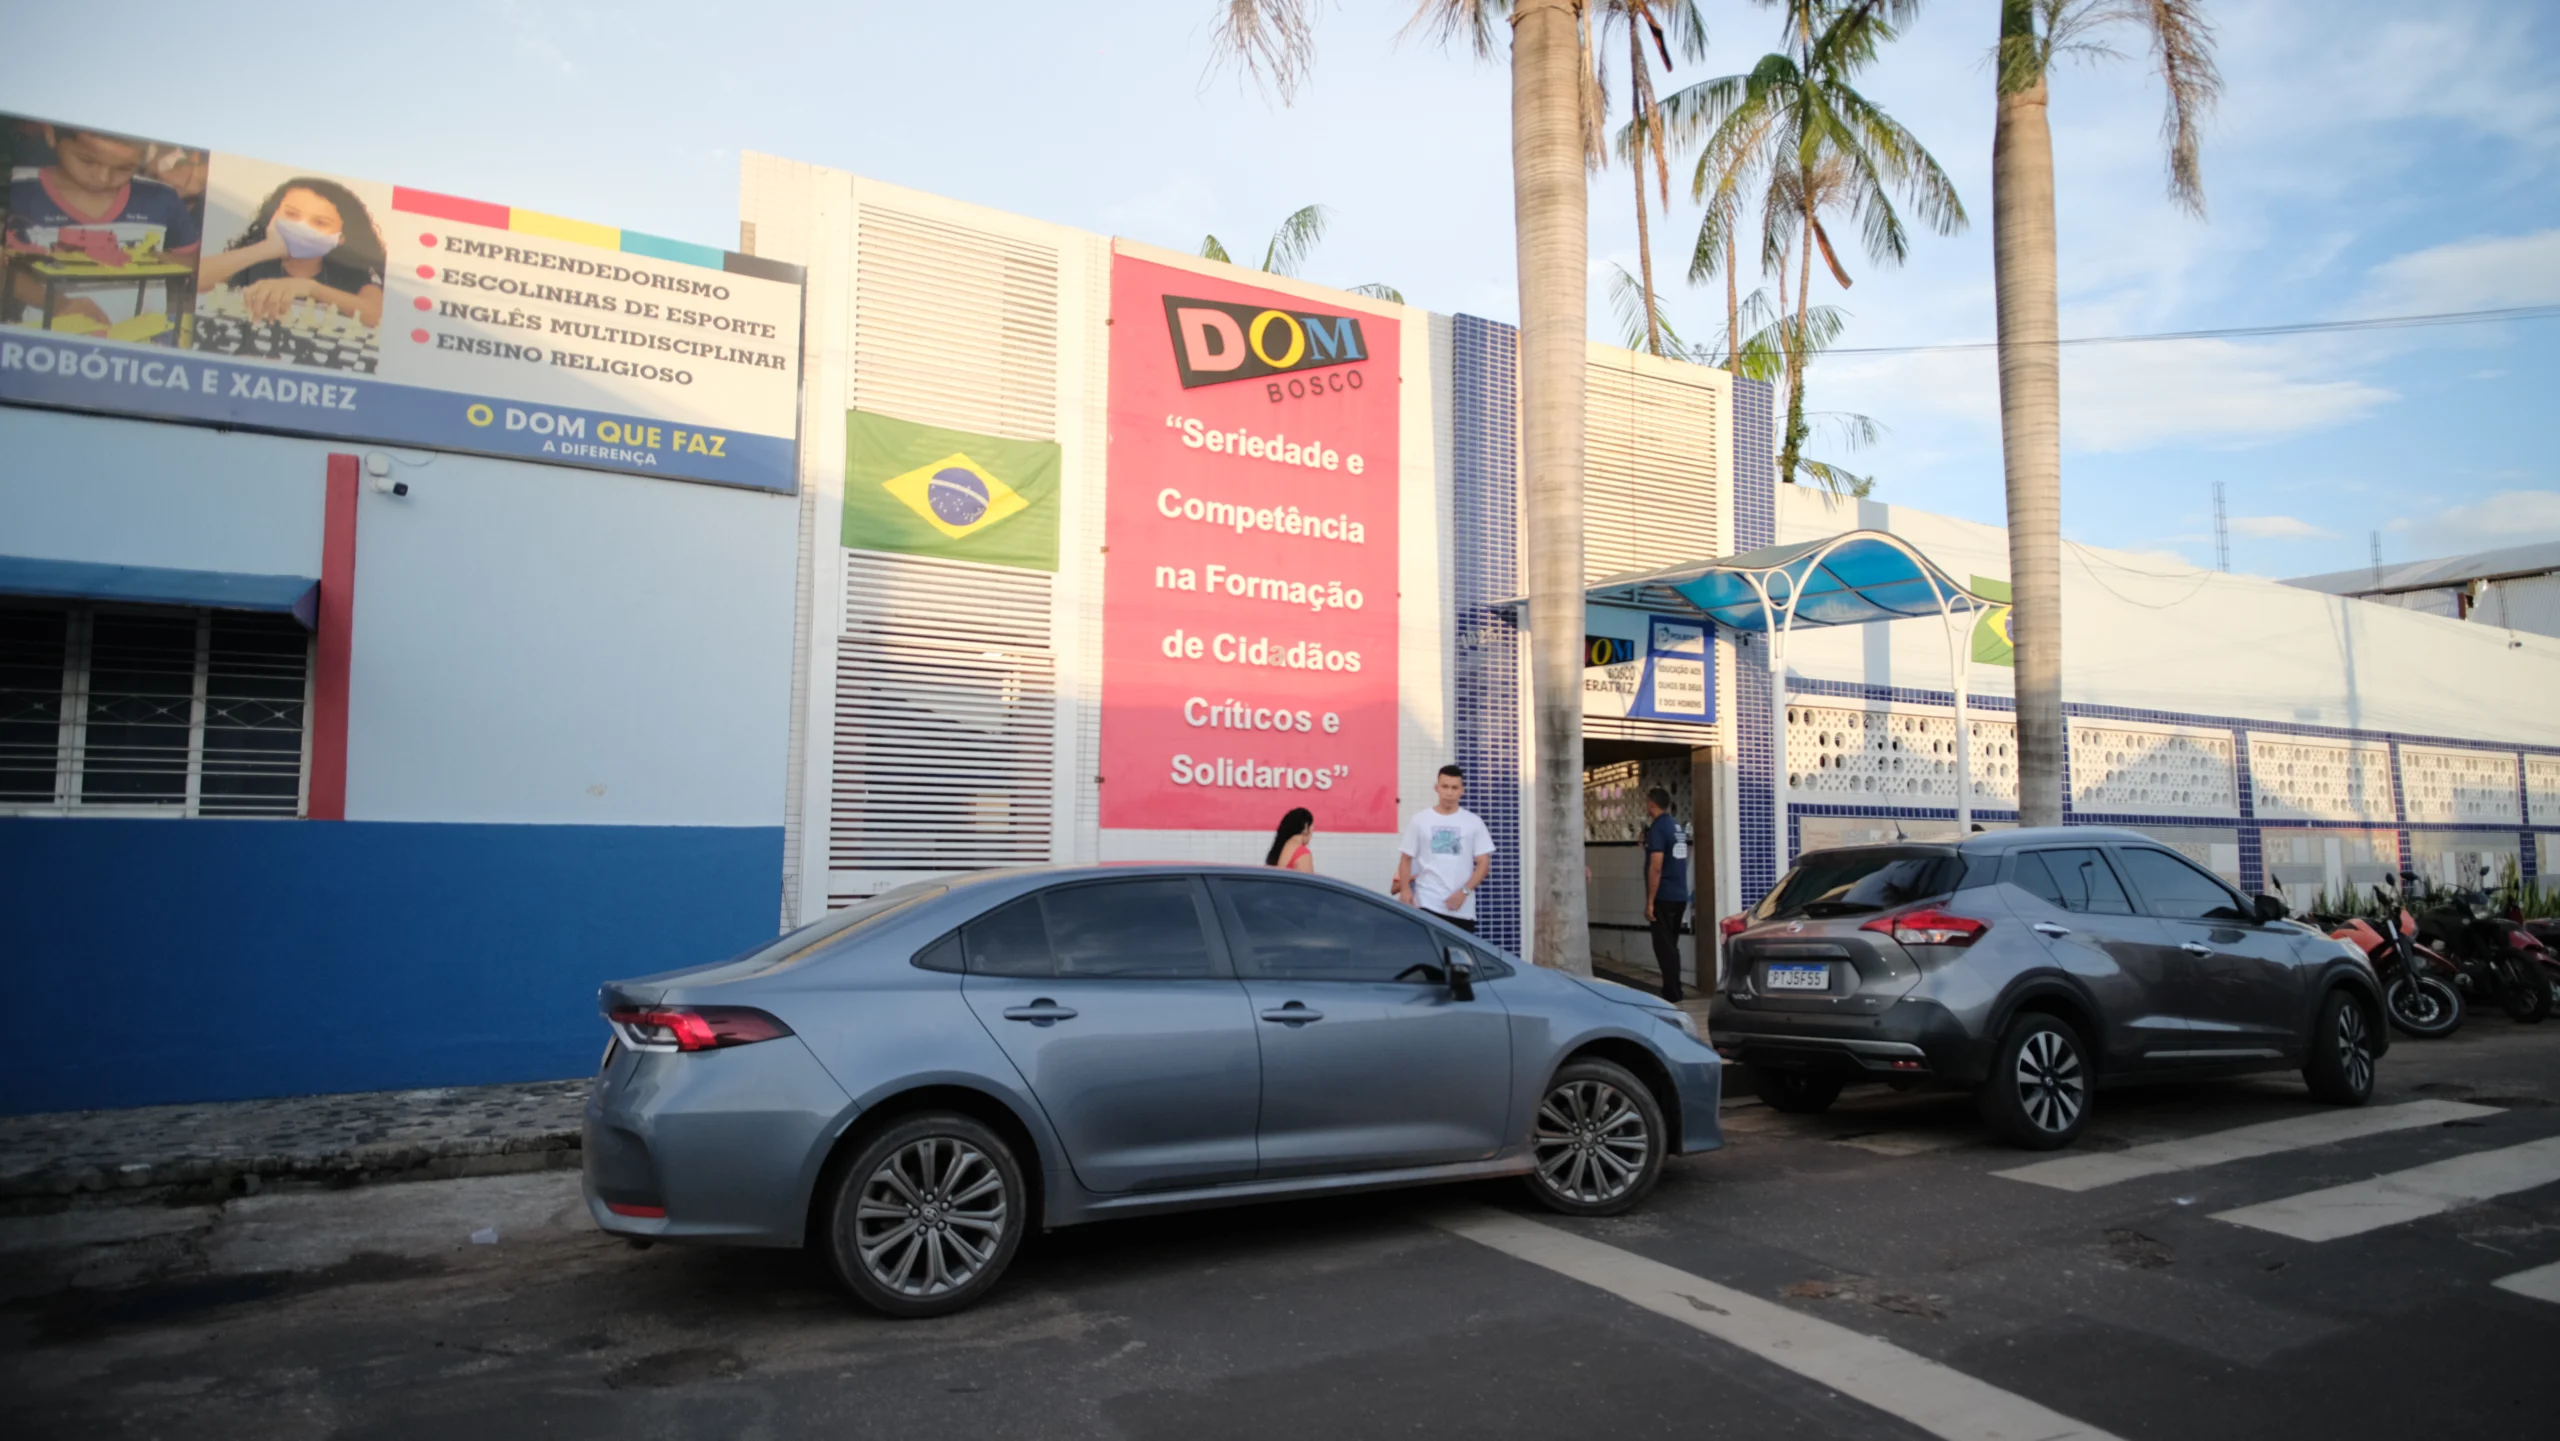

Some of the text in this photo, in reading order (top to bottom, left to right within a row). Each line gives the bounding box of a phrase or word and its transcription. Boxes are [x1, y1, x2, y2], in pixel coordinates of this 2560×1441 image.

[444, 236, 730, 300] EMPREENDEDORISMO
[441, 268, 776, 339] ESCOLINHAS DE ESPORTE
[436, 333, 693, 385] ENSINO RELIGIOSO
[438, 300, 786, 370] INGLÊS MULTIDISCIPLINAR
[1176, 307, 1365, 371] DOM
[2, 342, 357, 410] ROBÓTICA E XADREZ
[1267, 370, 1363, 403] BOSCO
[467, 404, 726, 457] O DOM QUE FAZ
[542, 440, 657, 466] A DIFERENÇA
[1347, 453, 1364, 475] e
[1157, 488, 1365, 544] Competência
[1155, 564, 1364, 612] na Formação
[1162, 629, 1361, 672] de Cidadãos
[1585, 679, 1635, 694] ERATRIZ
[1184, 696, 1340, 733] Críticos e
